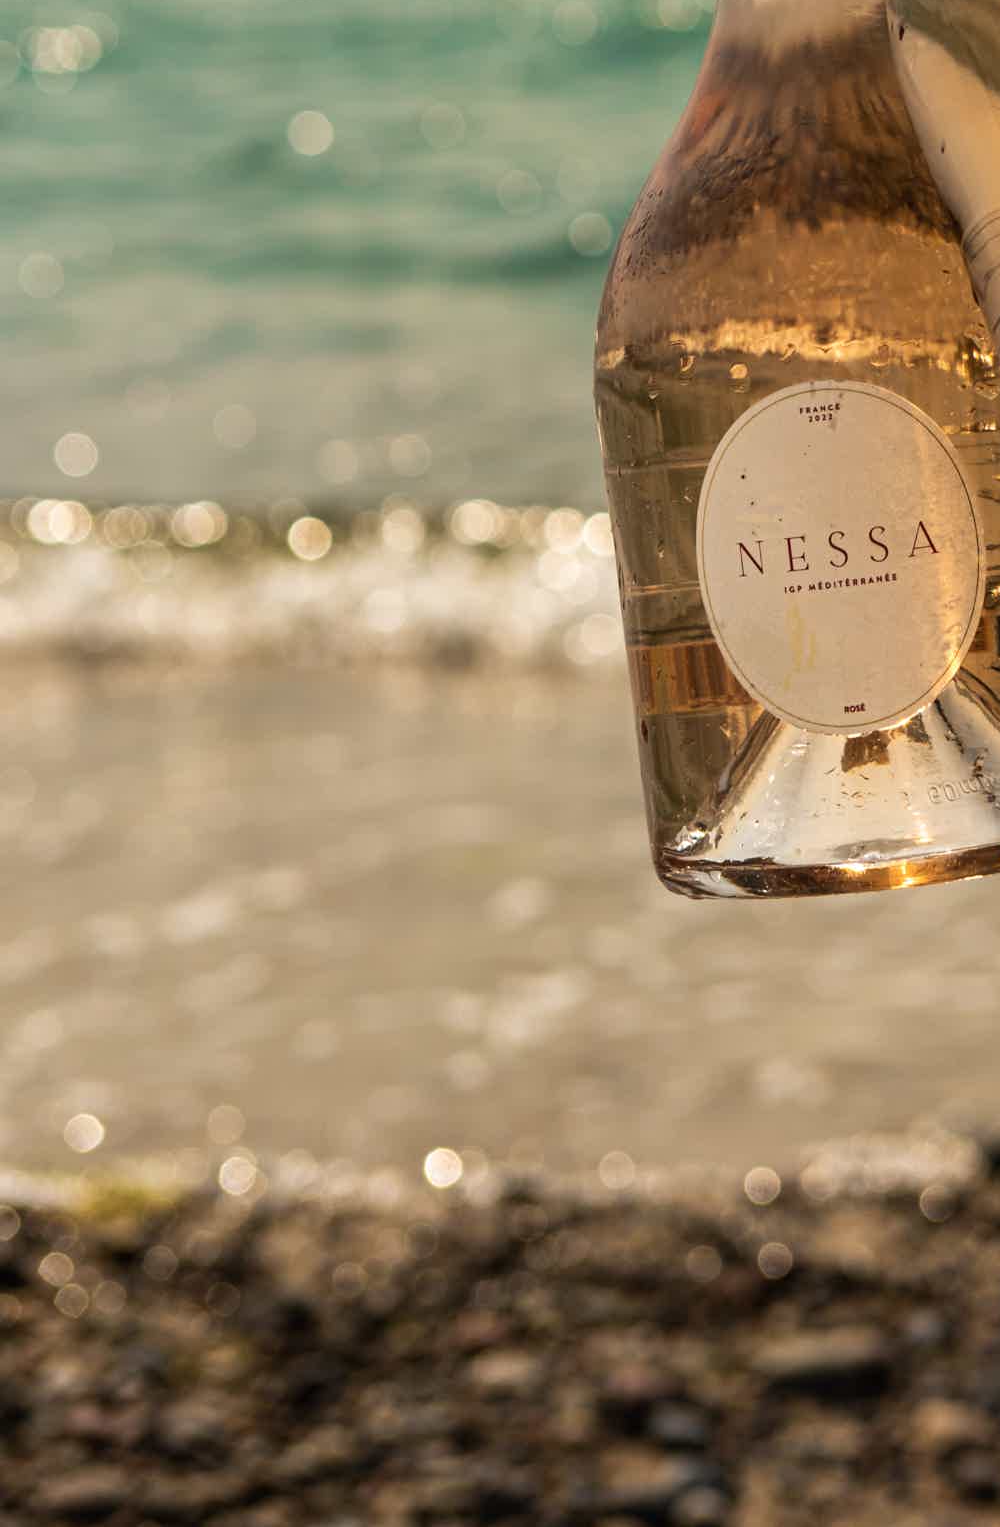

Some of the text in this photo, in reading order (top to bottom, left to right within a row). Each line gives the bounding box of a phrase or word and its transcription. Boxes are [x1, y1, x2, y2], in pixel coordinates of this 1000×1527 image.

[799, 402, 841, 415] FRANCE
[735, 520, 940, 578] NESSA
[784, 585, 803, 595] IGP
[843, 702, 866, 714] ROSÉ
